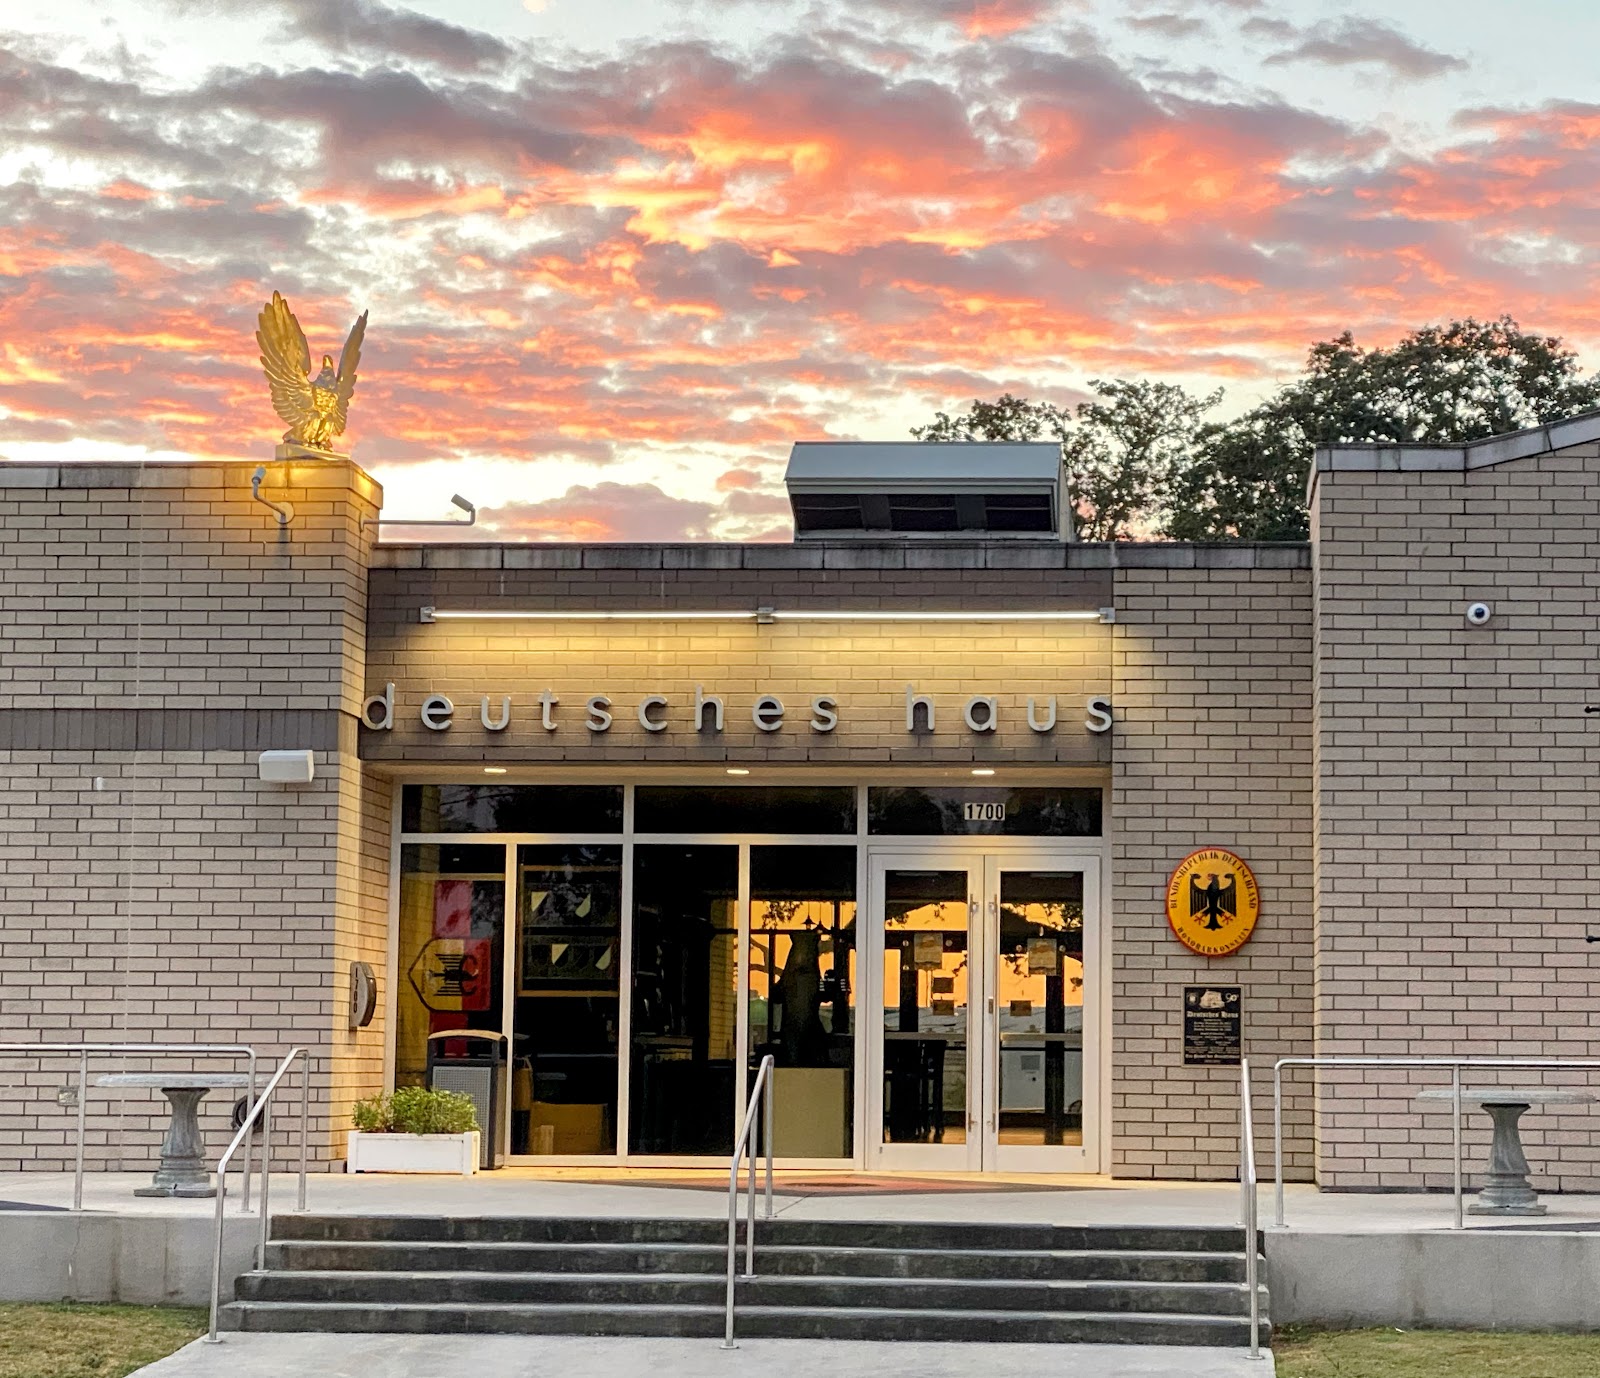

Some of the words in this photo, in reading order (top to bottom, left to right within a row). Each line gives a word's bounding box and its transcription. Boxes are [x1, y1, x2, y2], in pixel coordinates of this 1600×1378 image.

[361, 682, 838, 732] deutsches
[906, 683, 1113, 733] haus
[967, 803, 1004, 820] 1700
[1170, 851, 1219, 909] BUNDESREPUBLIK
[1221, 853, 1257, 909] DEUTSCHLAND
